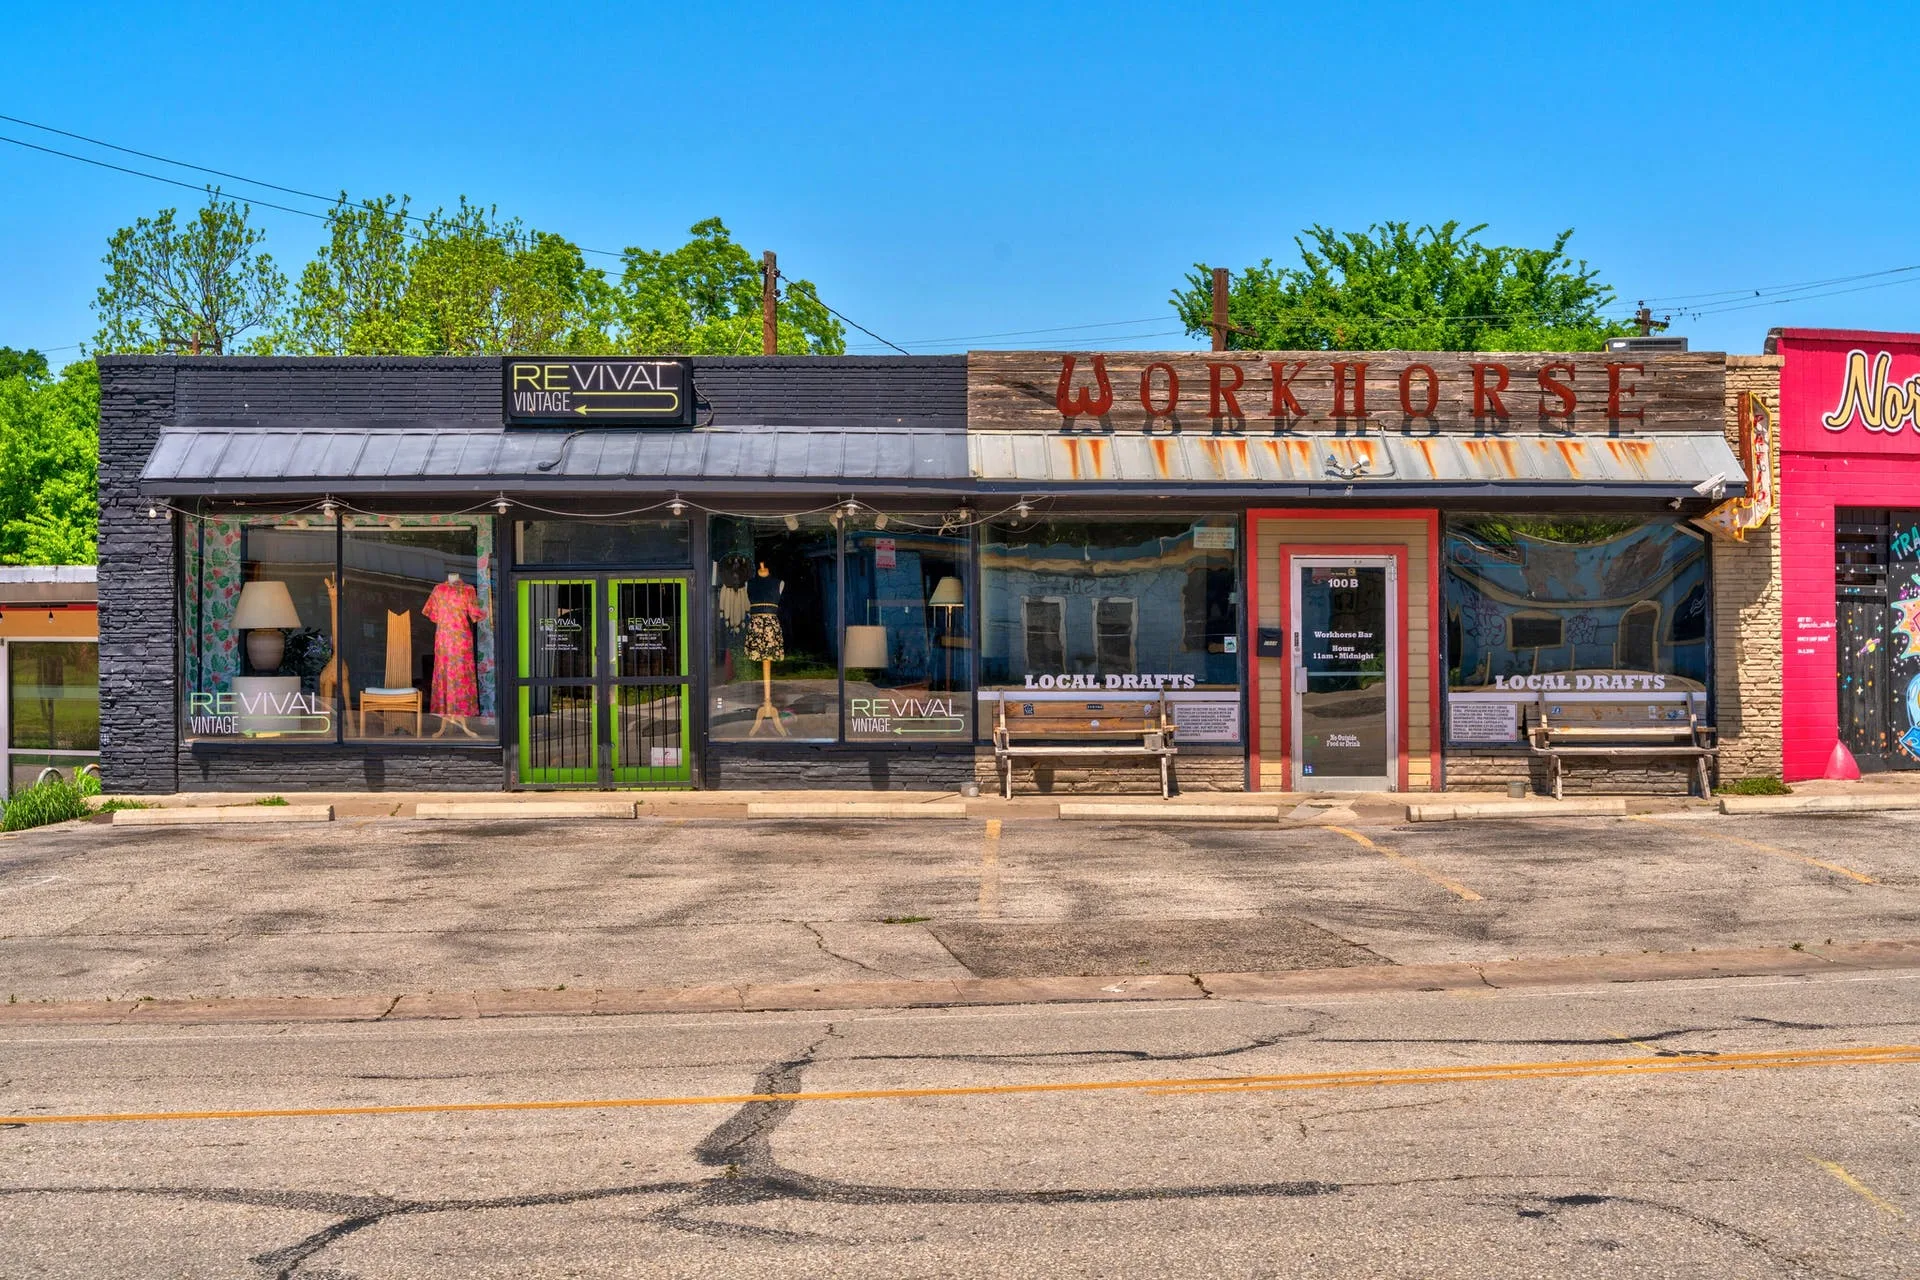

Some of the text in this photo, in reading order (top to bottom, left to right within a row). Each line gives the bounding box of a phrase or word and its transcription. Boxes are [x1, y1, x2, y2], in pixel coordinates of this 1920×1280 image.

[513, 365, 679, 391] REVIVAL
[1056, 354, 1645, 419] WORKHORSE
[513, 391, 571, 412] VINTAGE
[1327, 578, 1359, 588] 100 B
[627, 617, 667, 626] REVIVAL
[1313, 652, 1334, 660] 11am
[1338, 652, 1374, 661] Midnight
[1024, 674, 1195, 689] LOCAL DRAFTS
[1495, 675, 1666, 690] LOCAL DRAFTS
[190, 691, 330, 715] REVIVAL
[851, 698, 965, 717] REVIVAL
[190, 716, 239, 734] VINTAGE
[852, 717, 892, 733] VINTAGE
